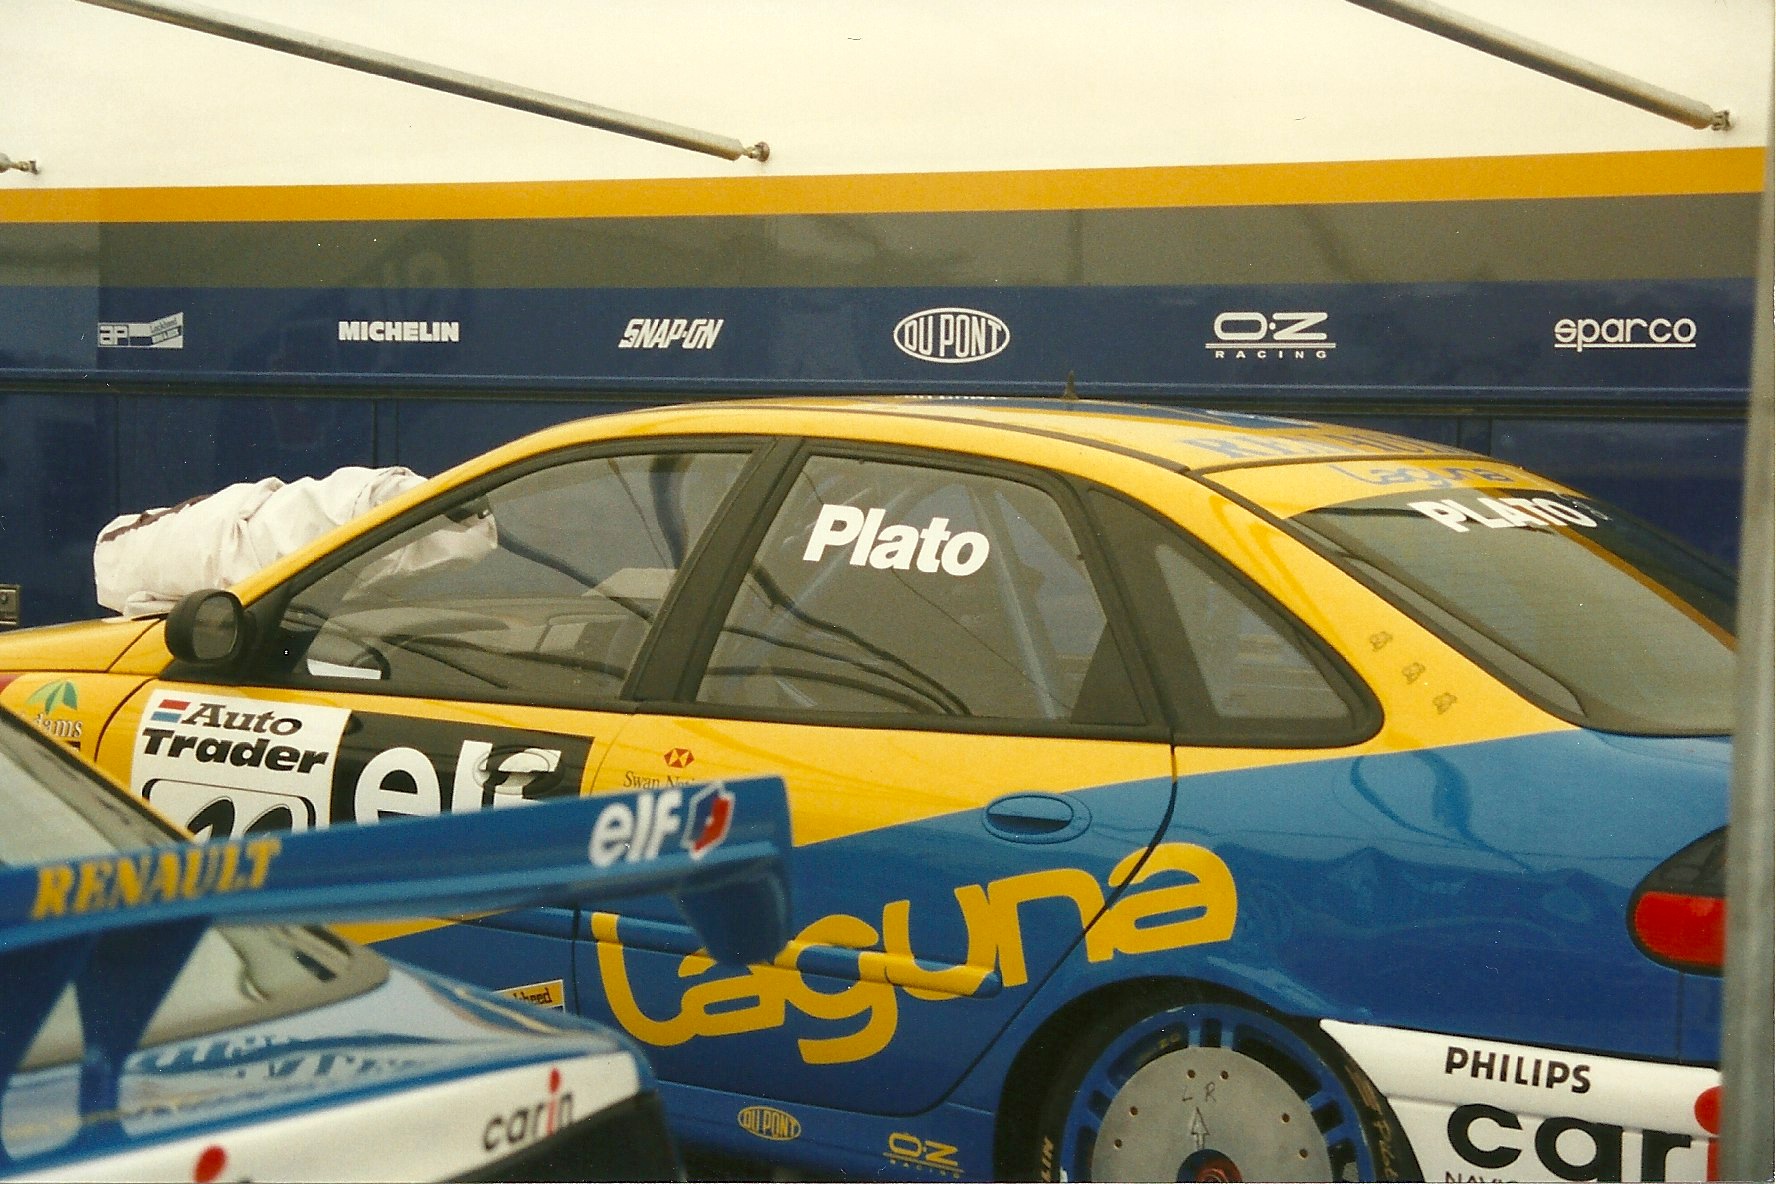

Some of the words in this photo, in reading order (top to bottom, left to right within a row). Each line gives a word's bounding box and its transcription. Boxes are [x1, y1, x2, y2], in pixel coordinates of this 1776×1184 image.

[338, 321, 460, 342] MICHELIN
[904, 317, 934, 355] DU
[939, 315, 1002, 358] PONT
[1554, 317, 1698, 352] sparco
[1215, 350, 1327, 359] RACING
[1406, 497, 1598, 532] PLATO
[803, 503, 990, 577] Plato
[181, 703, 303, 736] Auto
[142, 728, 330, 774] Trader
[623, 770, 660, 790] Swan
[588, 790, 684, 868] elf
[31, 837, 282, 920] RENAULT
[591, 842, 1237, 1064] Laguna
[1445, 1047, 1591, 1094] PHILIPS
[483, 1067, 574, 1152] carin
